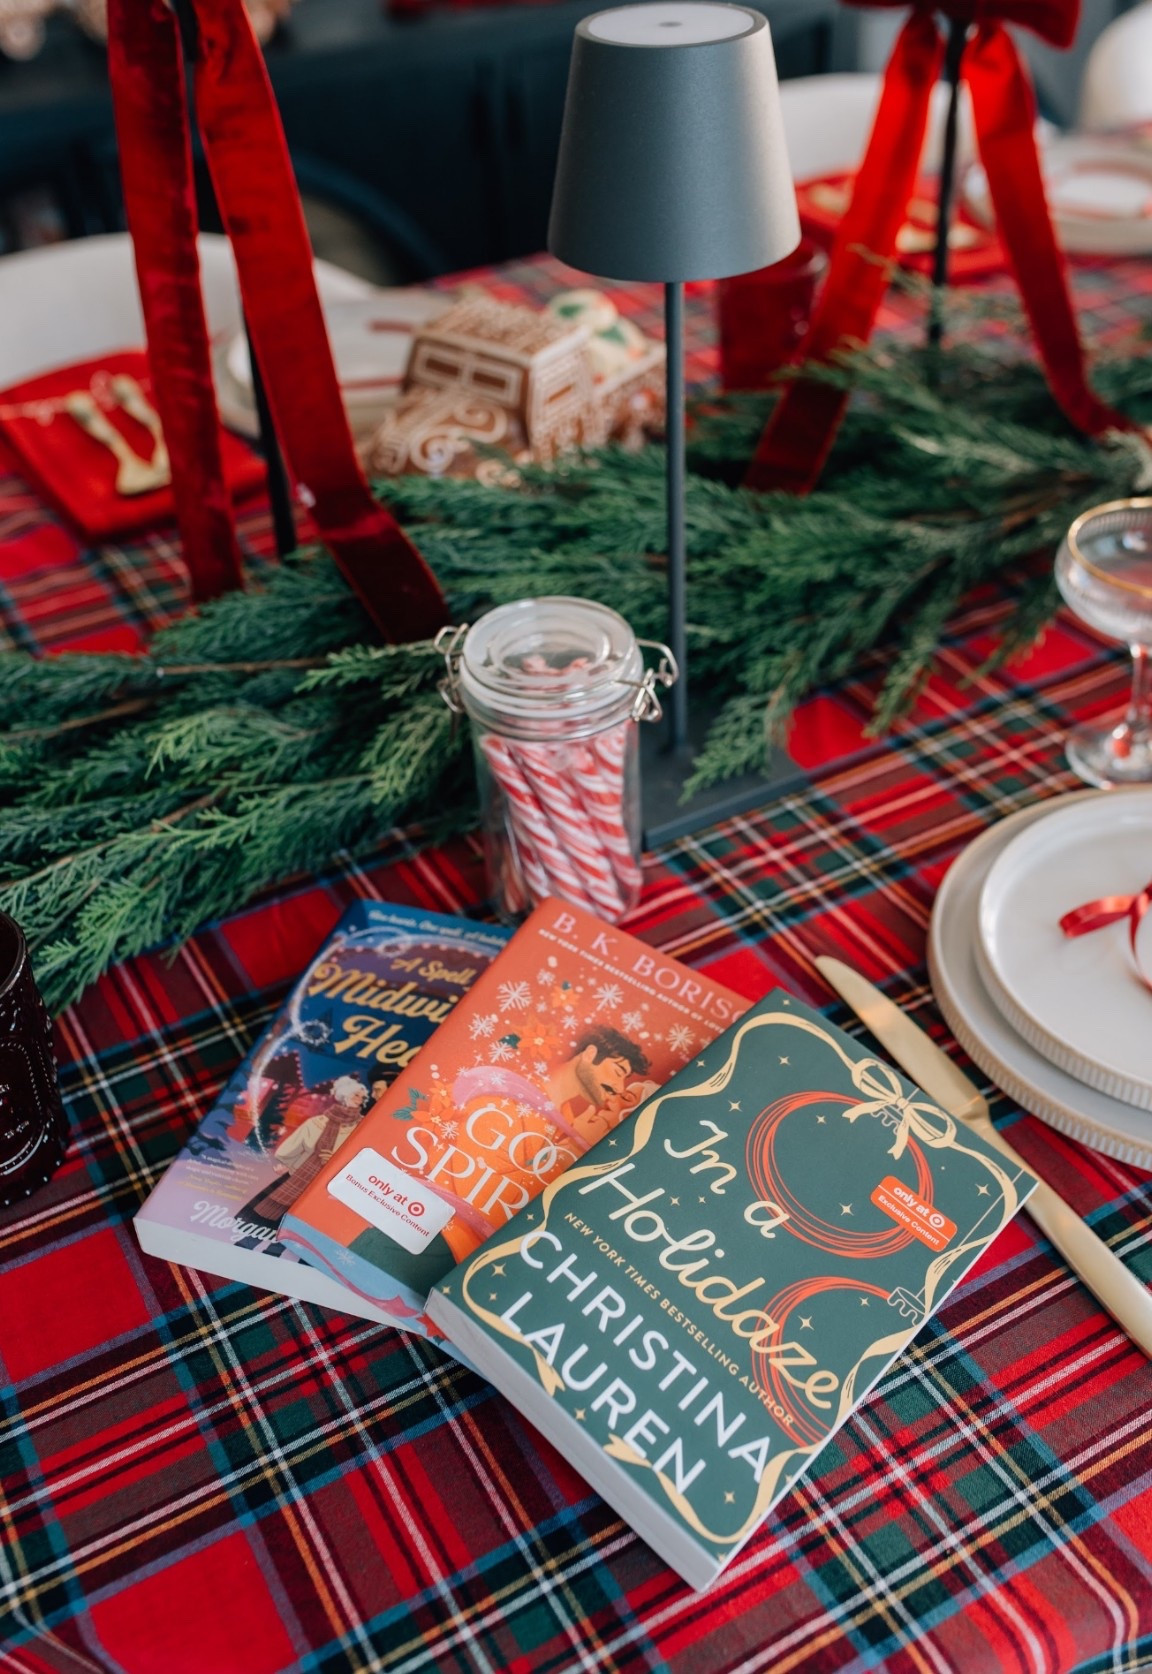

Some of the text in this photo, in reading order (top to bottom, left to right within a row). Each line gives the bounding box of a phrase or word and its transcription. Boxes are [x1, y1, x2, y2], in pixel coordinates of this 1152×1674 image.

[552, 911, 579, 940] B.
[590, 931, 619, 961] K.
[390, 957, 477, 985] A Spell
[579, 949, 604, 967] TIMES
[603, 963, 656, 995] BESTSELLING
[656, 992, 690, 1015] AUTHOR
[663, 1120, 738, 1195] In
[346, 1174, 430, 1237] Bonus Exclusive Content
[368, 1175, 408, 1206] only at
[743, 1199, 790, 1239] a
[878, 1195, 940, 1246] Exclusive Content
[893, 1187, 930, 1217] only at
[578, 1162, 840, 1410] Holidaze
[564, 1212, 793, 1427] NEW YORK TIMES BESTSELLING AUTHOR
[520, 1231, 770, 1483] CHRISTINA
[501, 1292, 706, 1494] LAUREN
